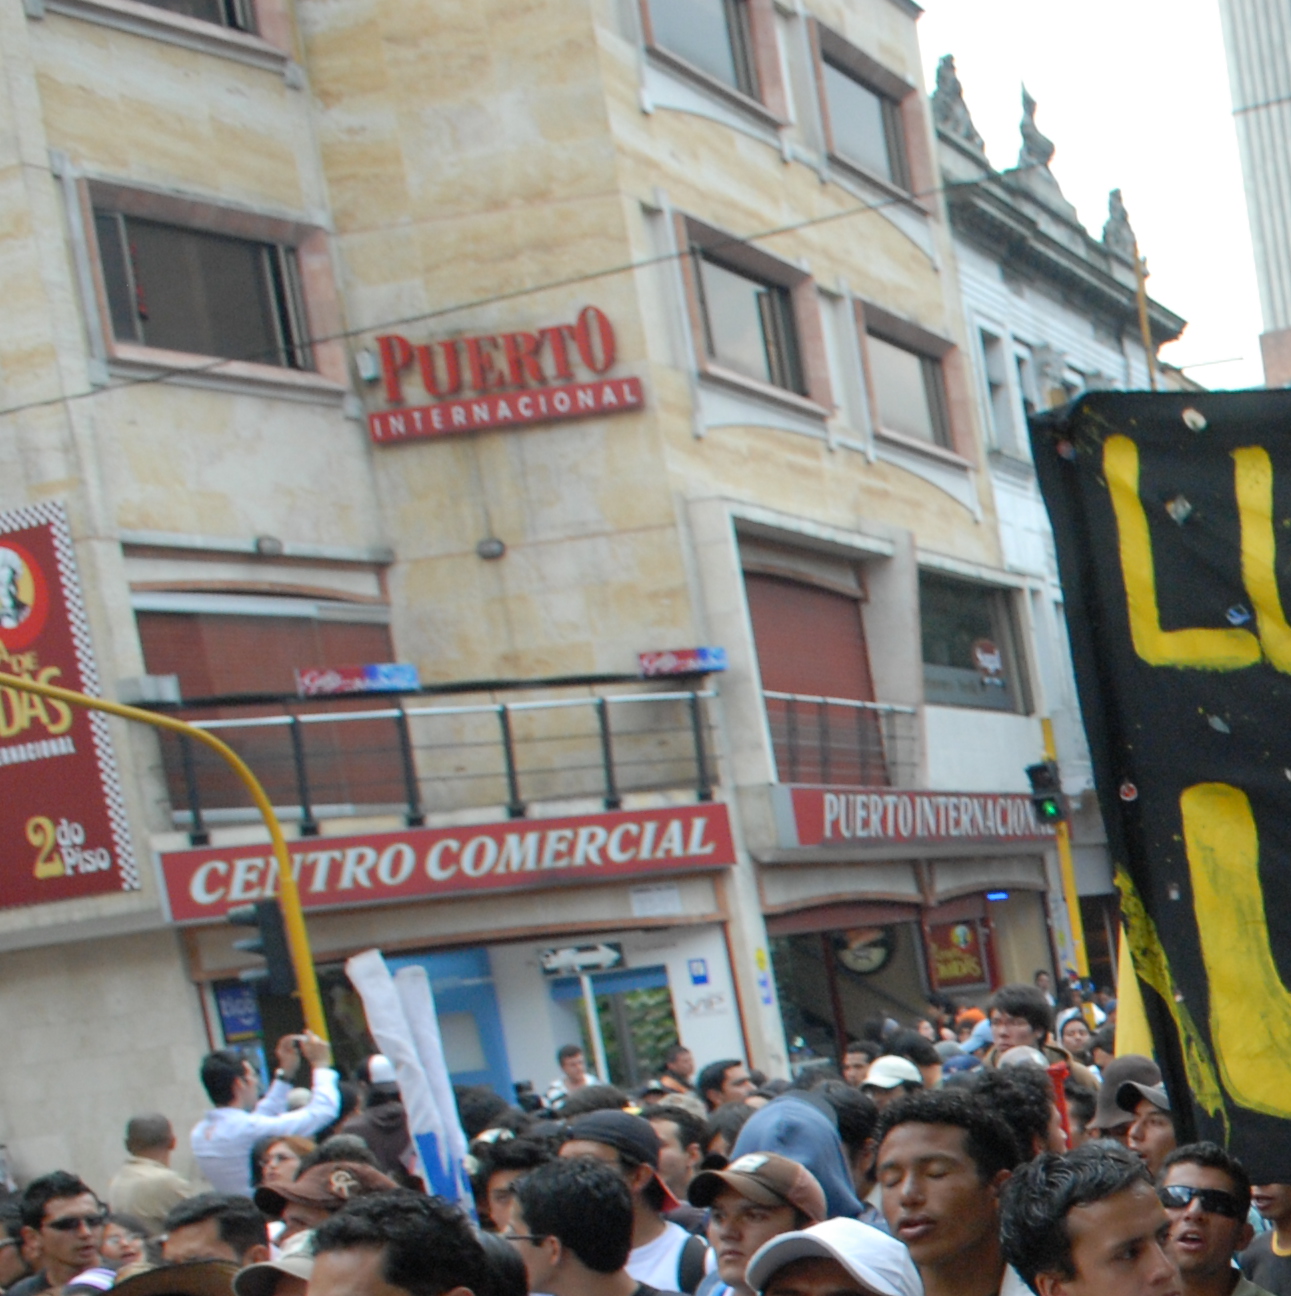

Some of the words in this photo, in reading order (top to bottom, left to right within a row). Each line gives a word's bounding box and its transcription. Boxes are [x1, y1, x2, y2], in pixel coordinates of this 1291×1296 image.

[376, 305, 617, 404] PUERTO
[372, 382, 638, 438] INTERNACIONAL
[823, 793, 915, 838] PUERTO
[915, 796, 1056, 837] INTERNACION
[62, 845, 112, 877] Piso
[190, 841, 415, 905] CENTRO
[425, 816, 715, 882] COMERCIAL
